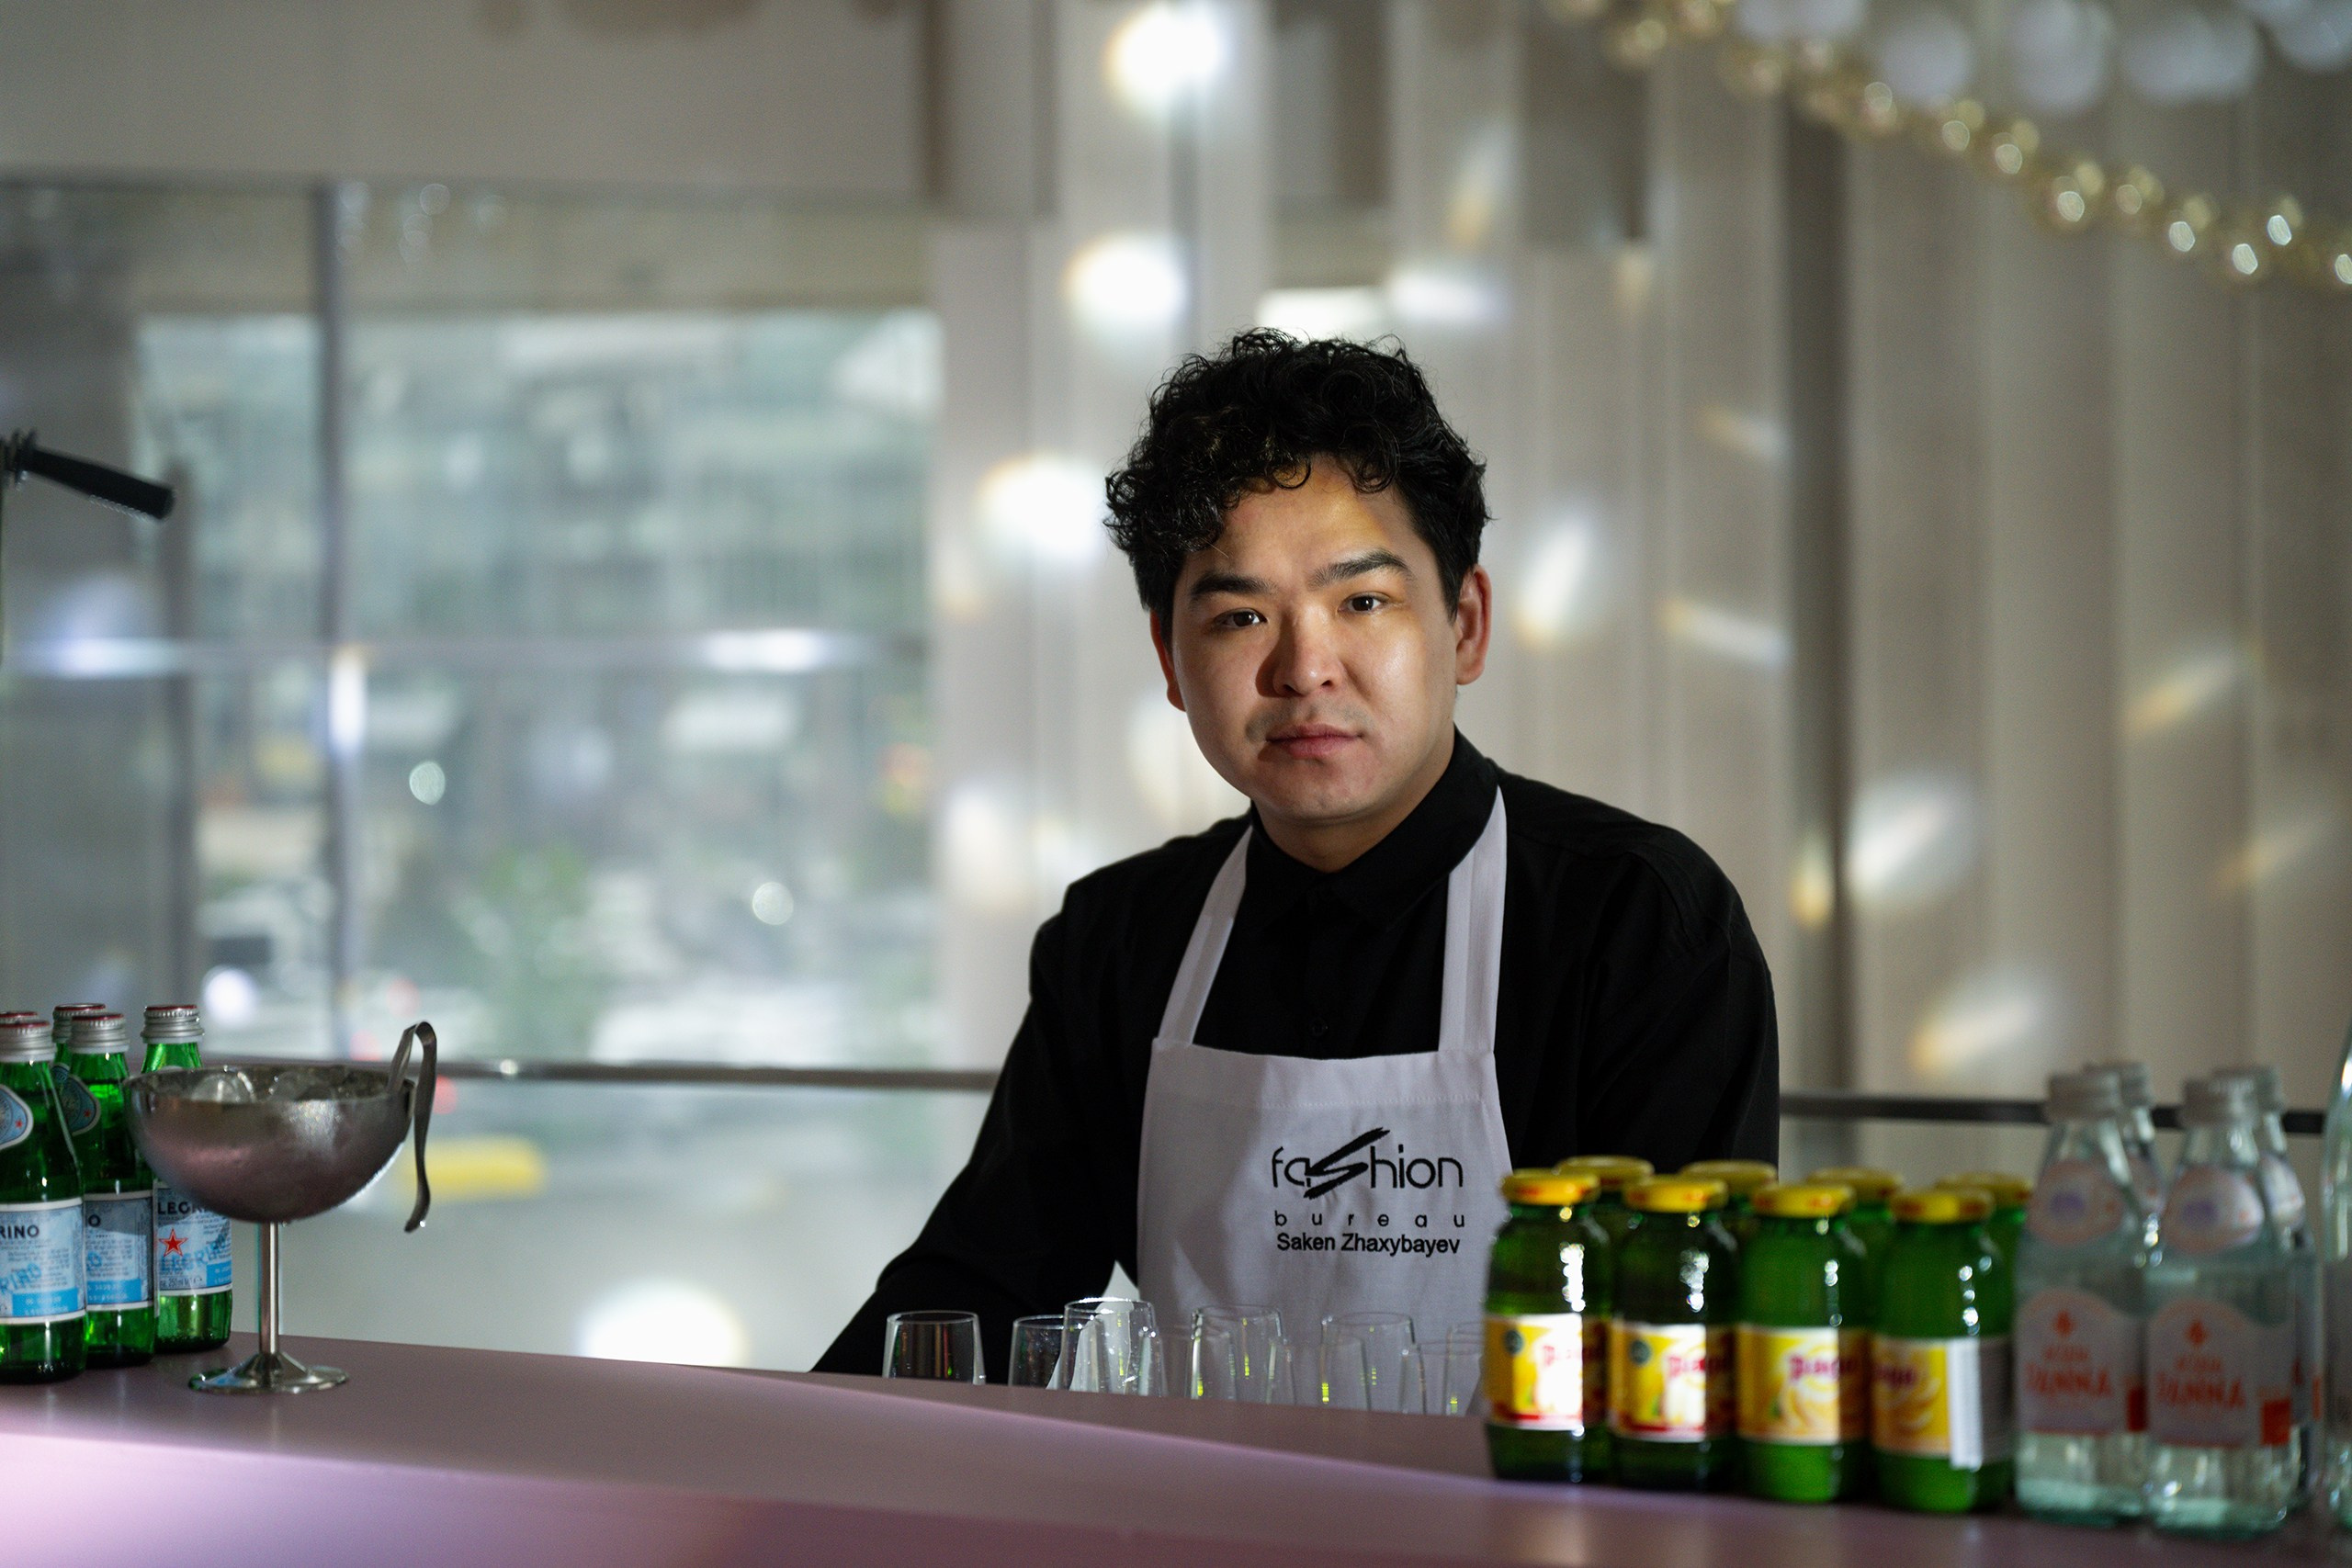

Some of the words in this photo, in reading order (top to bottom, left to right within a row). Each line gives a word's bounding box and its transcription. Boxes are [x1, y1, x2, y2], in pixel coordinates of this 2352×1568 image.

[1274, 1210, 1465, 1228] bureau
[1276, 1232, 1336, 1251] Saken
[1340, 1233, 1461, 1258] Zhaxybayev
